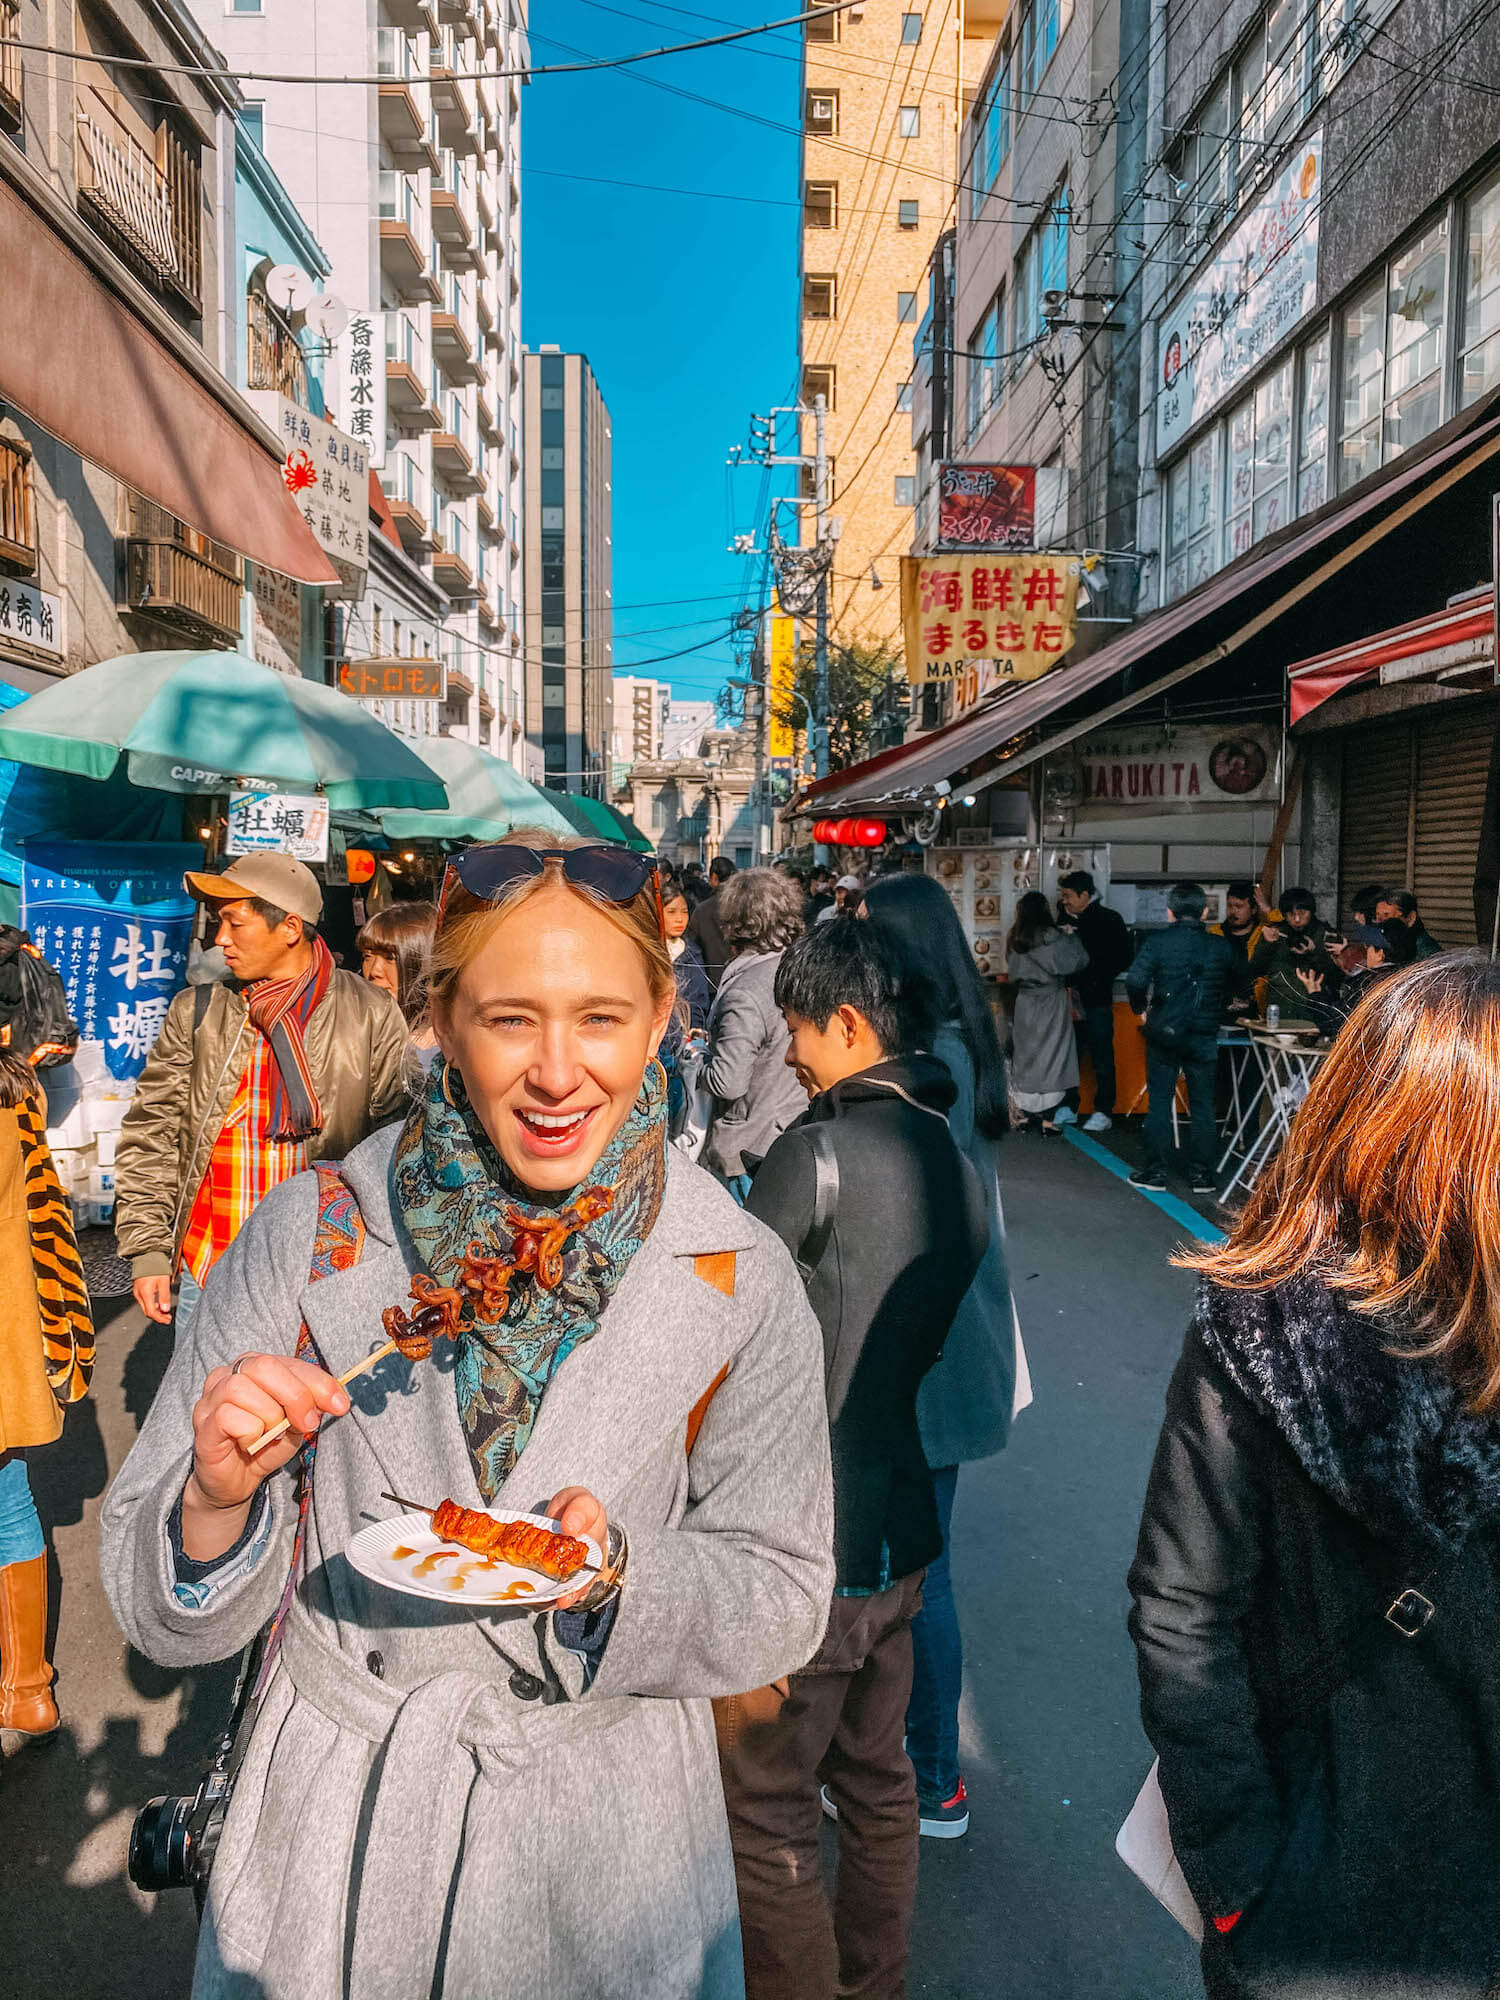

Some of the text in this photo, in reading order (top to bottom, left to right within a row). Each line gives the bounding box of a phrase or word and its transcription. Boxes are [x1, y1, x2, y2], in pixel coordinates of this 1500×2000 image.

[920, 567, 1065, 613] 海鮮丼
[923, 620, 1063, 655] まるきた
[31, 879, 95, 889] FRESH
[52, 925, 67, 974] 毎日、よ
[108, 923, 175, 1059] 牡蠣
